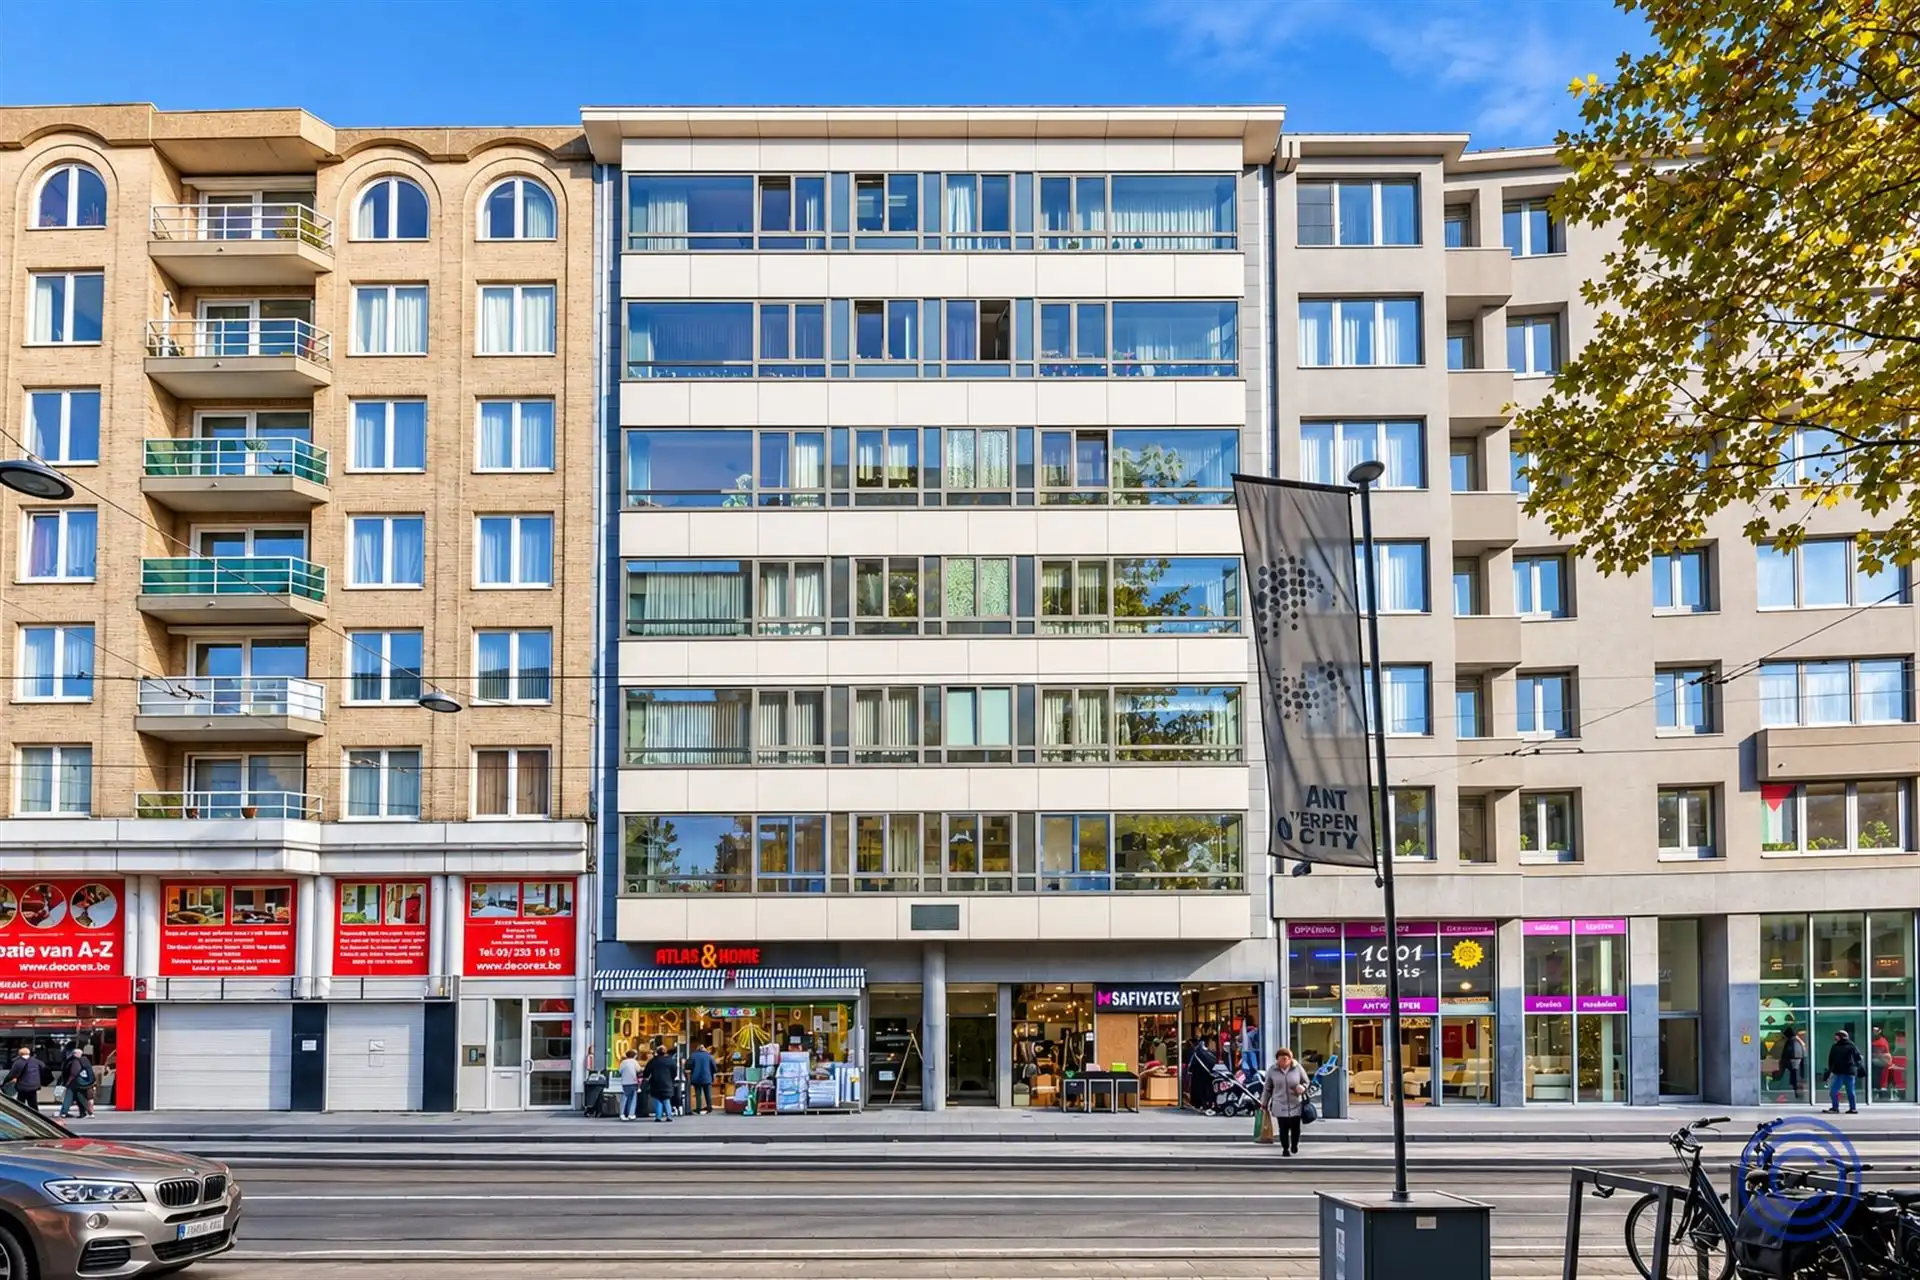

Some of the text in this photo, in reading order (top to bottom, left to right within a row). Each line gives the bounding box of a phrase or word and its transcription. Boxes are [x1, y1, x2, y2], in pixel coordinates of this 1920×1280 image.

[1306, 785, 1347, 811] ANT
[1299, 828, 1358, 849] CITY
[40, 945, 73, 958] van
[77, 940, 114, 958] A-Z
[656, 944, 760, 968] ATLAS & HOME
[1361, 945, 1422, 962] 1001
[1112, 991, 1180, 1006] SAFIYATEX
